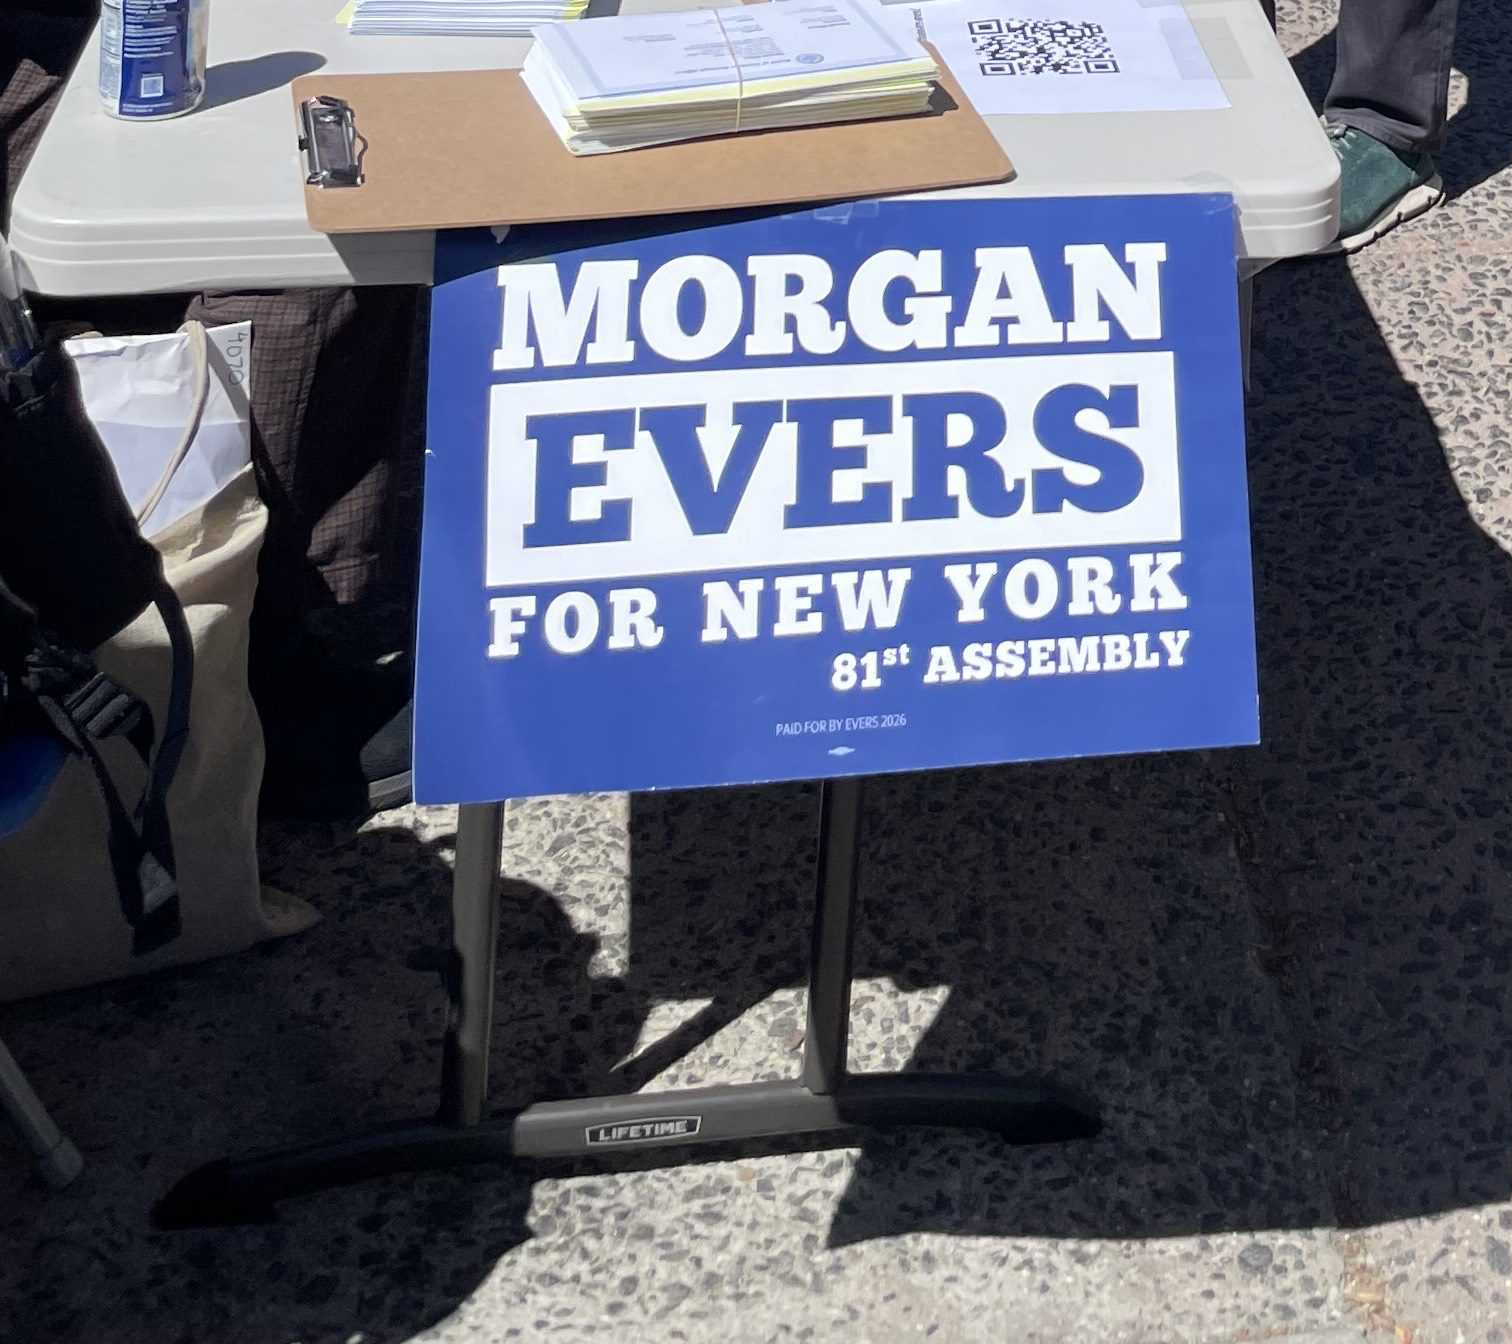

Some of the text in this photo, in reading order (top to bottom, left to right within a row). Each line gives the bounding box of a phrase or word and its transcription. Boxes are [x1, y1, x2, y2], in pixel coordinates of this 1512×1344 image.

[491, 242, 1167, 371] MORGAN
[522, 382, 1146, 549] EVERS
[487, 550, 1188, 660] FOR NEW YORK
[831, 630, 1190, 691] 81st ASSEMBLY
[776, 714, 907, 736] PAID FOR BY EVERS 2026
[598, 1120, 688, 1141] LIFETIME
